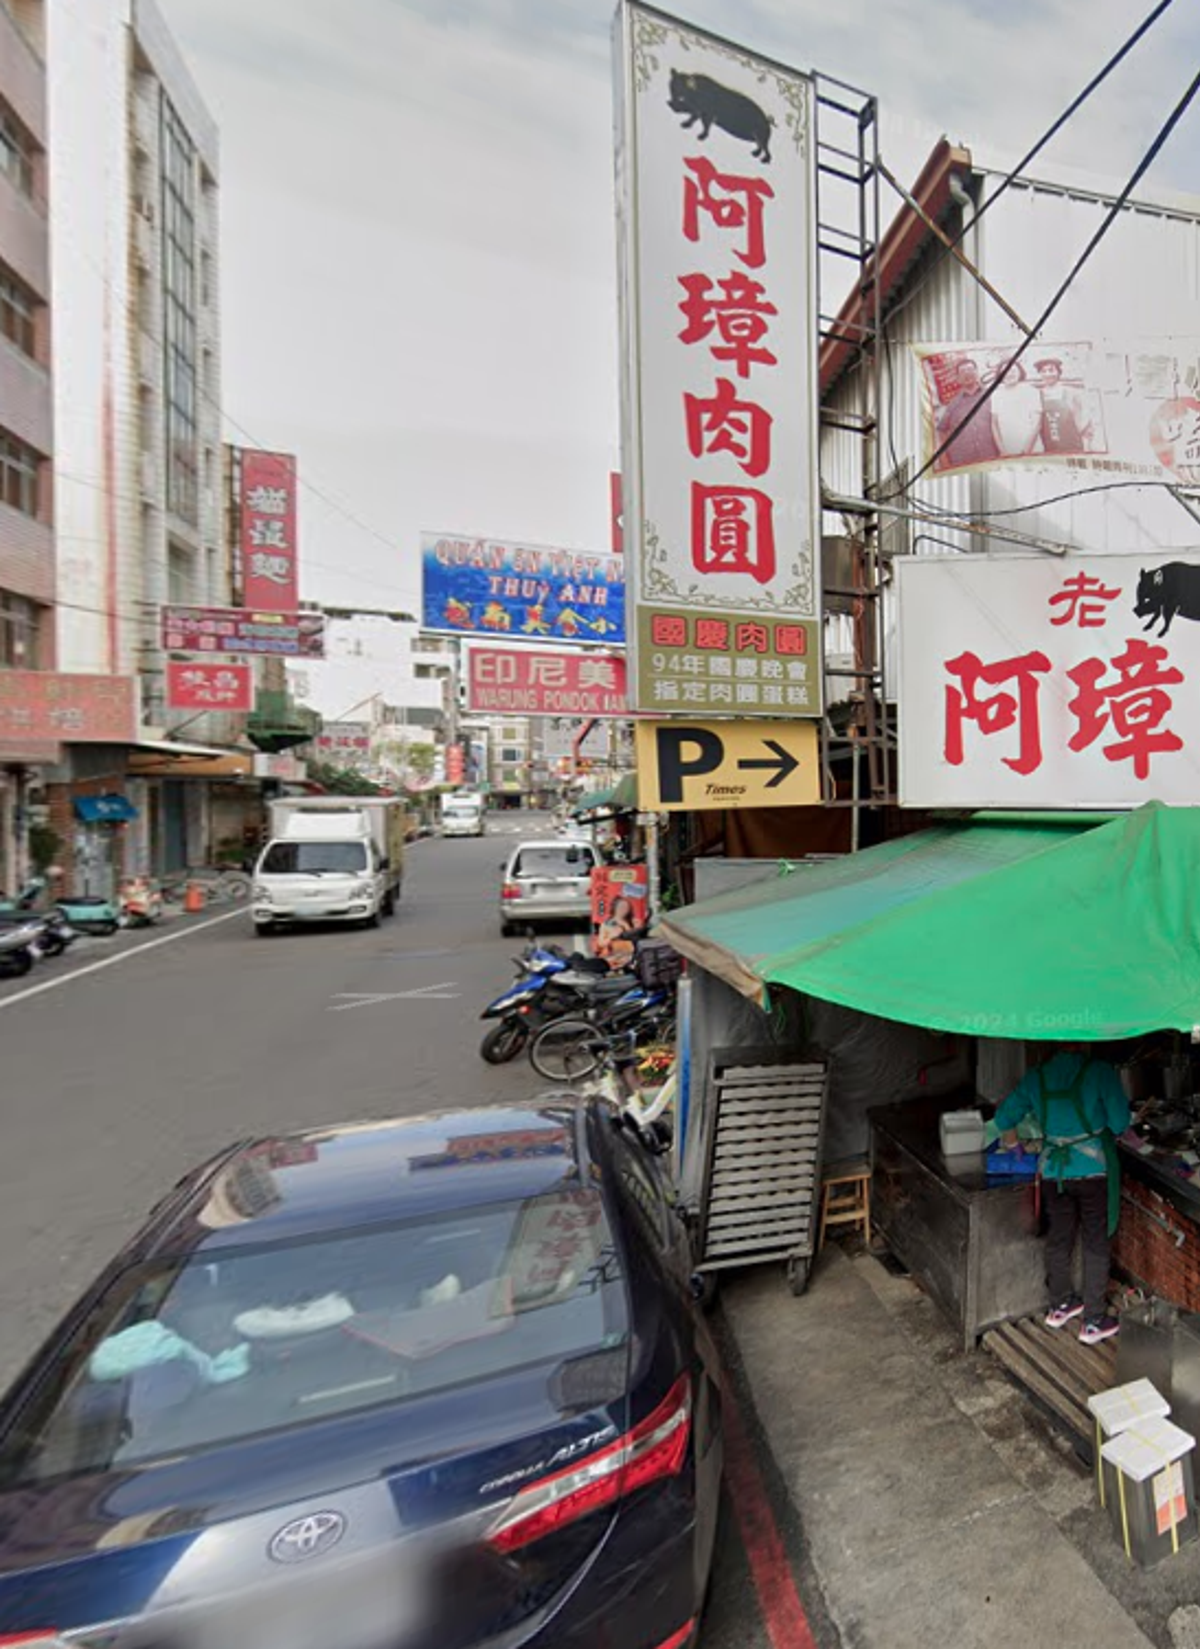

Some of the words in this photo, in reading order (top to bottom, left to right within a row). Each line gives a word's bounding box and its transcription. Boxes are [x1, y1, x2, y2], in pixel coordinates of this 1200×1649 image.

[678, 155, 778, 585] 阿璋肉圓
[559, 583, 609, 606] ANH
[1048, 571, 1122, 628] 老
[652, 614, 808, 656] 國慶肉圓
[474, 652, 617, 689] 印尼美
[652, 653, 808, 681] 94年國慶晚會
[475, 688, 537, 709] WARUNG
[544, 690, 600, 711] PONDOK
[653, 680, 809, 706] 指定肉圓蛋糕
[656, 726, 725, 804] P
[705, 783, 747, 796] Times
